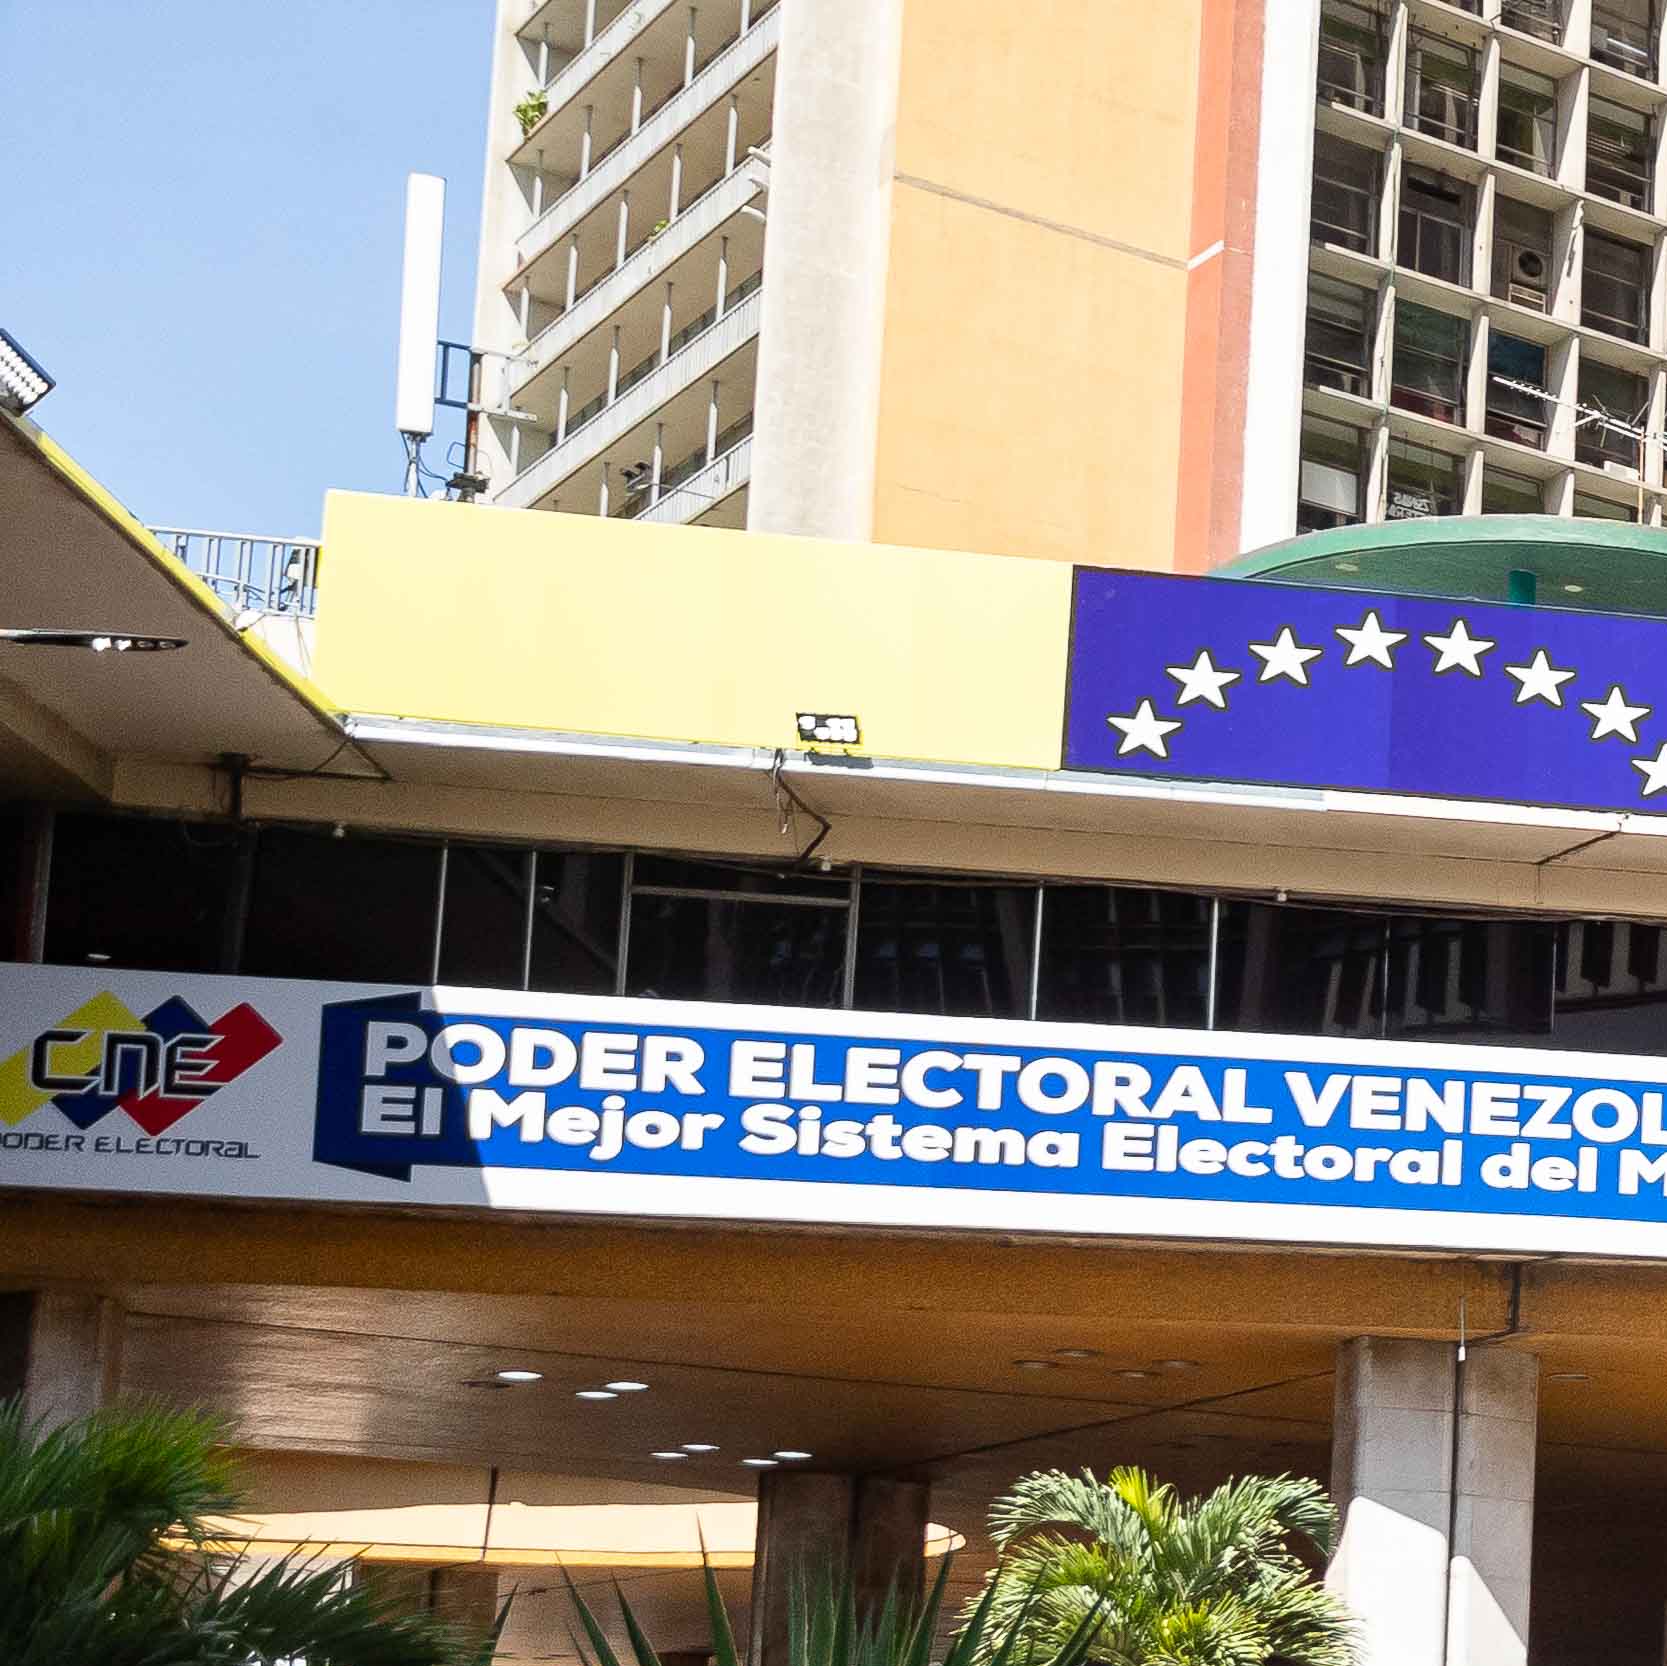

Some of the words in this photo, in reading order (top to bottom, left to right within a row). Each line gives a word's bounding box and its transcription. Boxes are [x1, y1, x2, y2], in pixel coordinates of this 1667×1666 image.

[30, 1029, 227, 1099] CNE
[364, 1020, 706, 1095] PODER
[728, 1039, 1273, 1124] ELECTORAL
[0, 1131, 85, 1152] ODER
[94, 1136, 261, 1159] ELECTORAL
[360, 1084, 443, 1136] El
[468, 1088, 725, 1161] Mejor
[738, 1102, 1080, 1171] Sistema
[1102, 1121, 1463, 1187] Electoral
[1480, 1139, 1599, 1194] del
